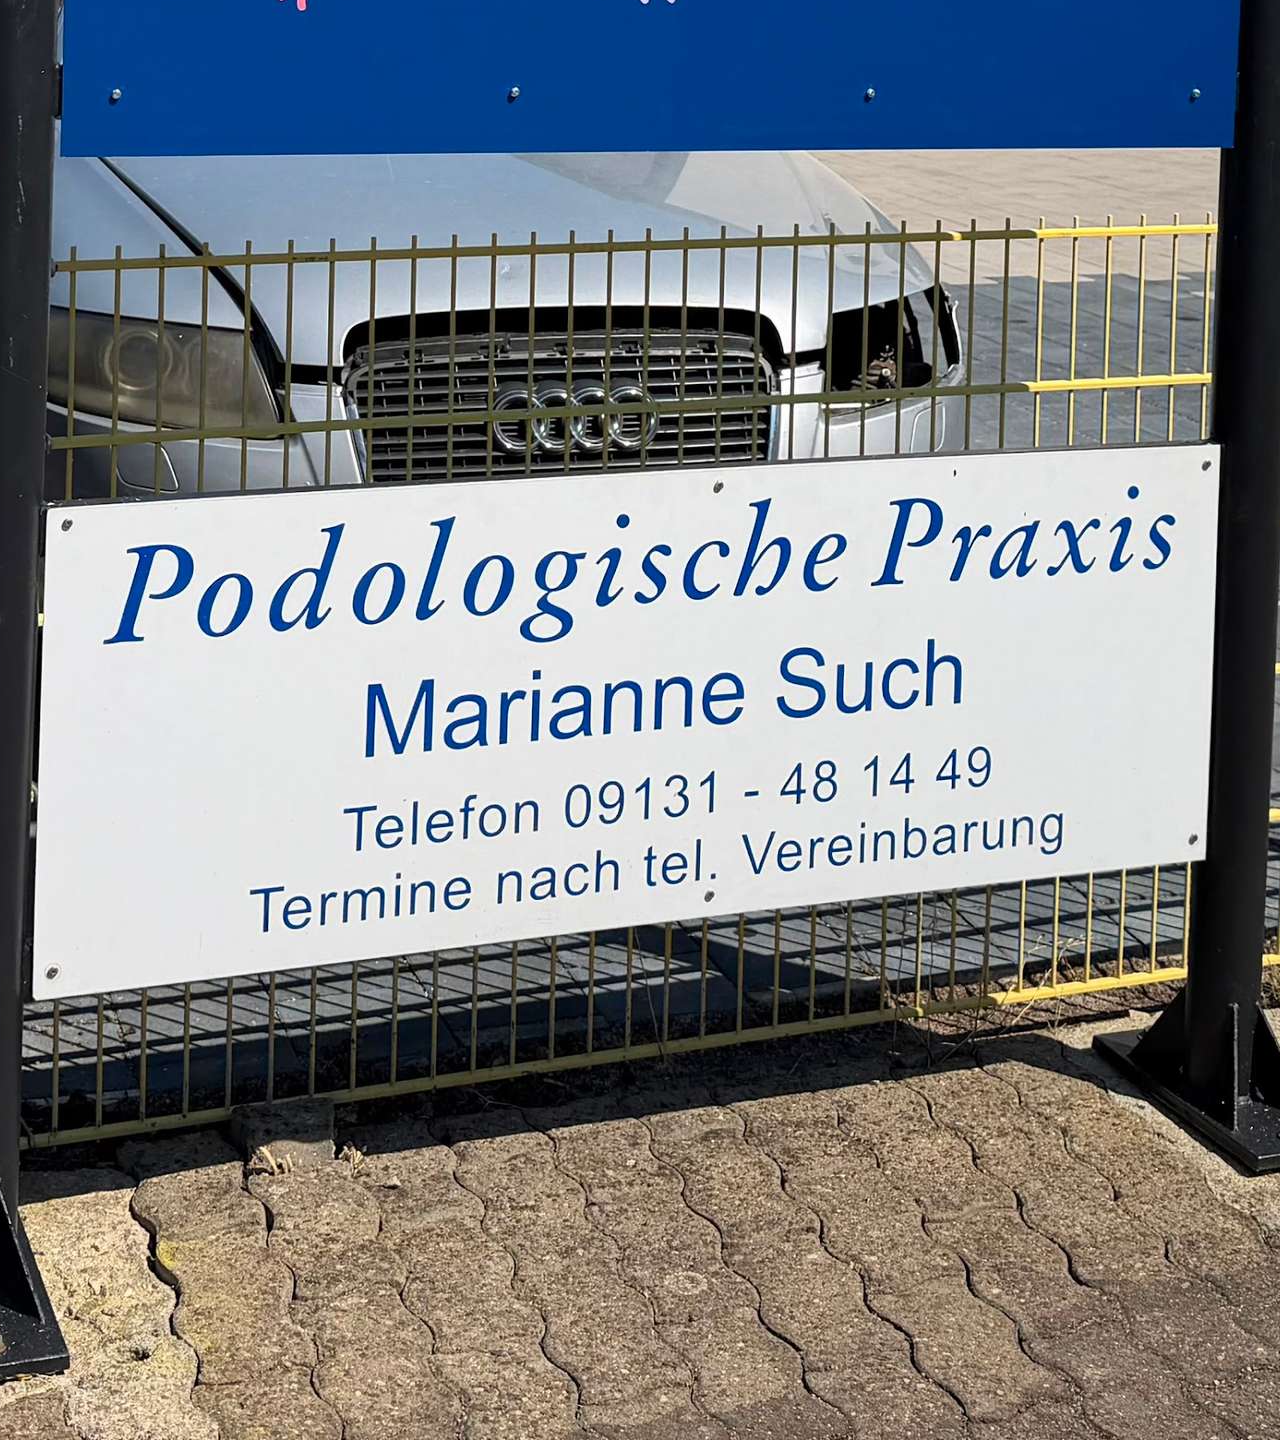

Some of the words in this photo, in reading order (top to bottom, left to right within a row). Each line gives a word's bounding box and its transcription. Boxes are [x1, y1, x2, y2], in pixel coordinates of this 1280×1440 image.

[102, 497, 848, 645] Podologische
[870, 485, 1176, 587] Praxis
[364, 669, 745, 758] Marianne
[776, 638, 963, 719] Such
[343, 794, 539, 852] Telefon
[564, 770, 715, 829] 09131
[744, 790, 760, 798] -
[779, 759, 838, 805] 48
[863, 752, 915, 797] 14
[935, 746, 992, 790] 49
[249, 872, 472, 933] Termine
[497, 849, 620, 905] nach
[643, 838, 718, 887] tel.
[741, 812, 1064, 875] Vereinbarung
